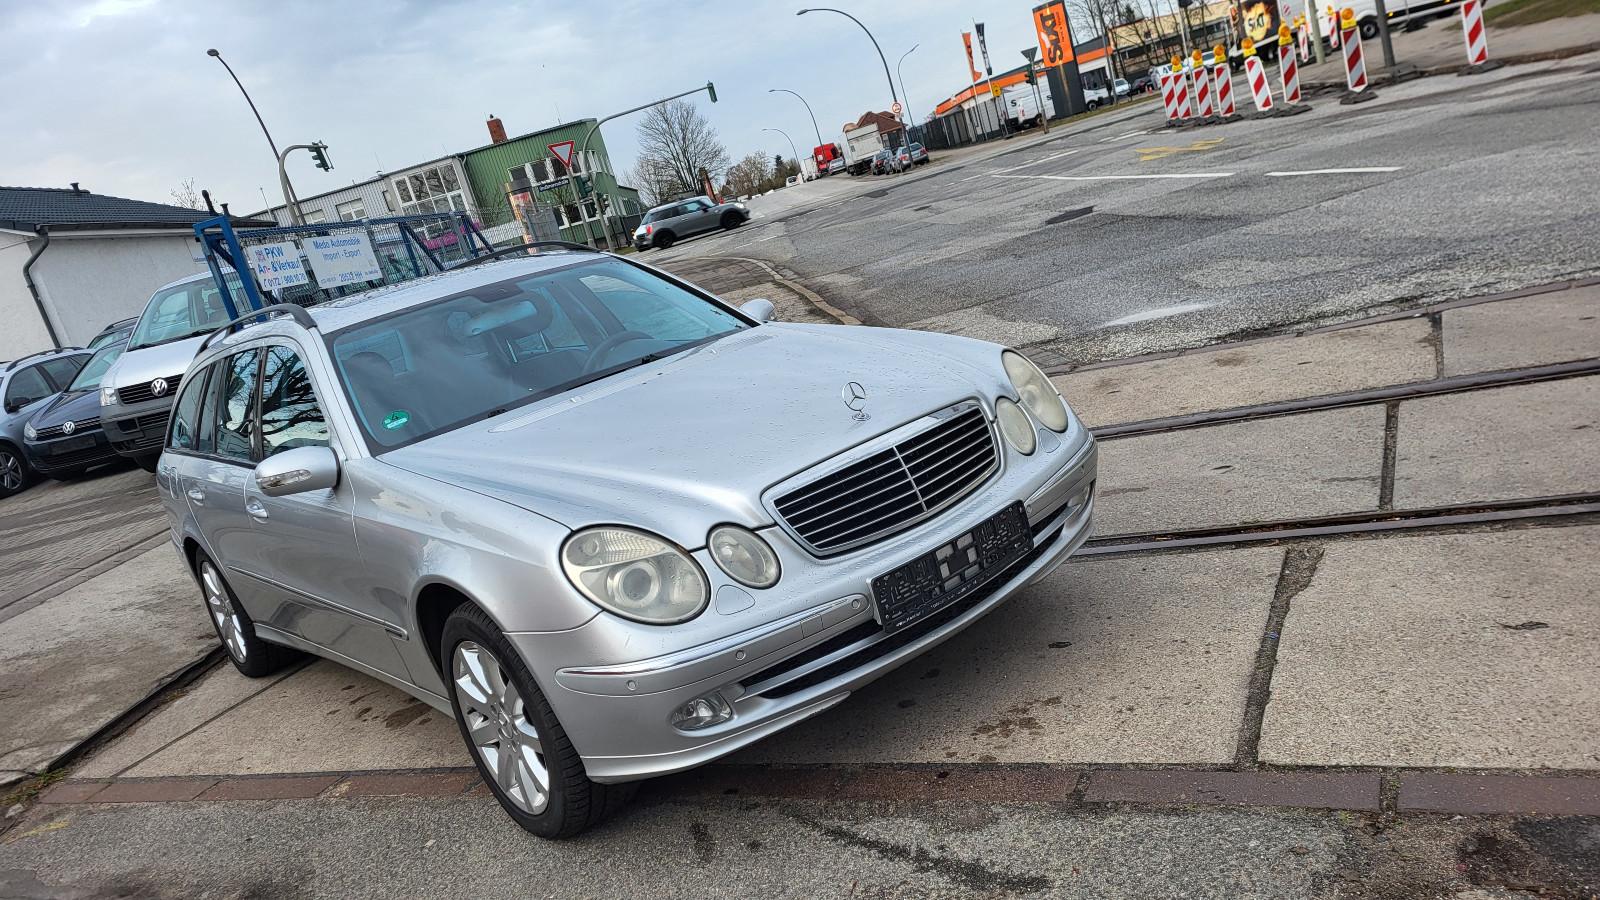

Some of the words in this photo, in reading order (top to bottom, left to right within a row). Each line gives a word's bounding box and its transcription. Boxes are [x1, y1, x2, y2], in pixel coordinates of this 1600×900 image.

[264, 246, 284, 259] PKW
[322, 250, 341, 261] Import
[344, 248, 361, 259] Export
[257, 263, 271, 274] An-
